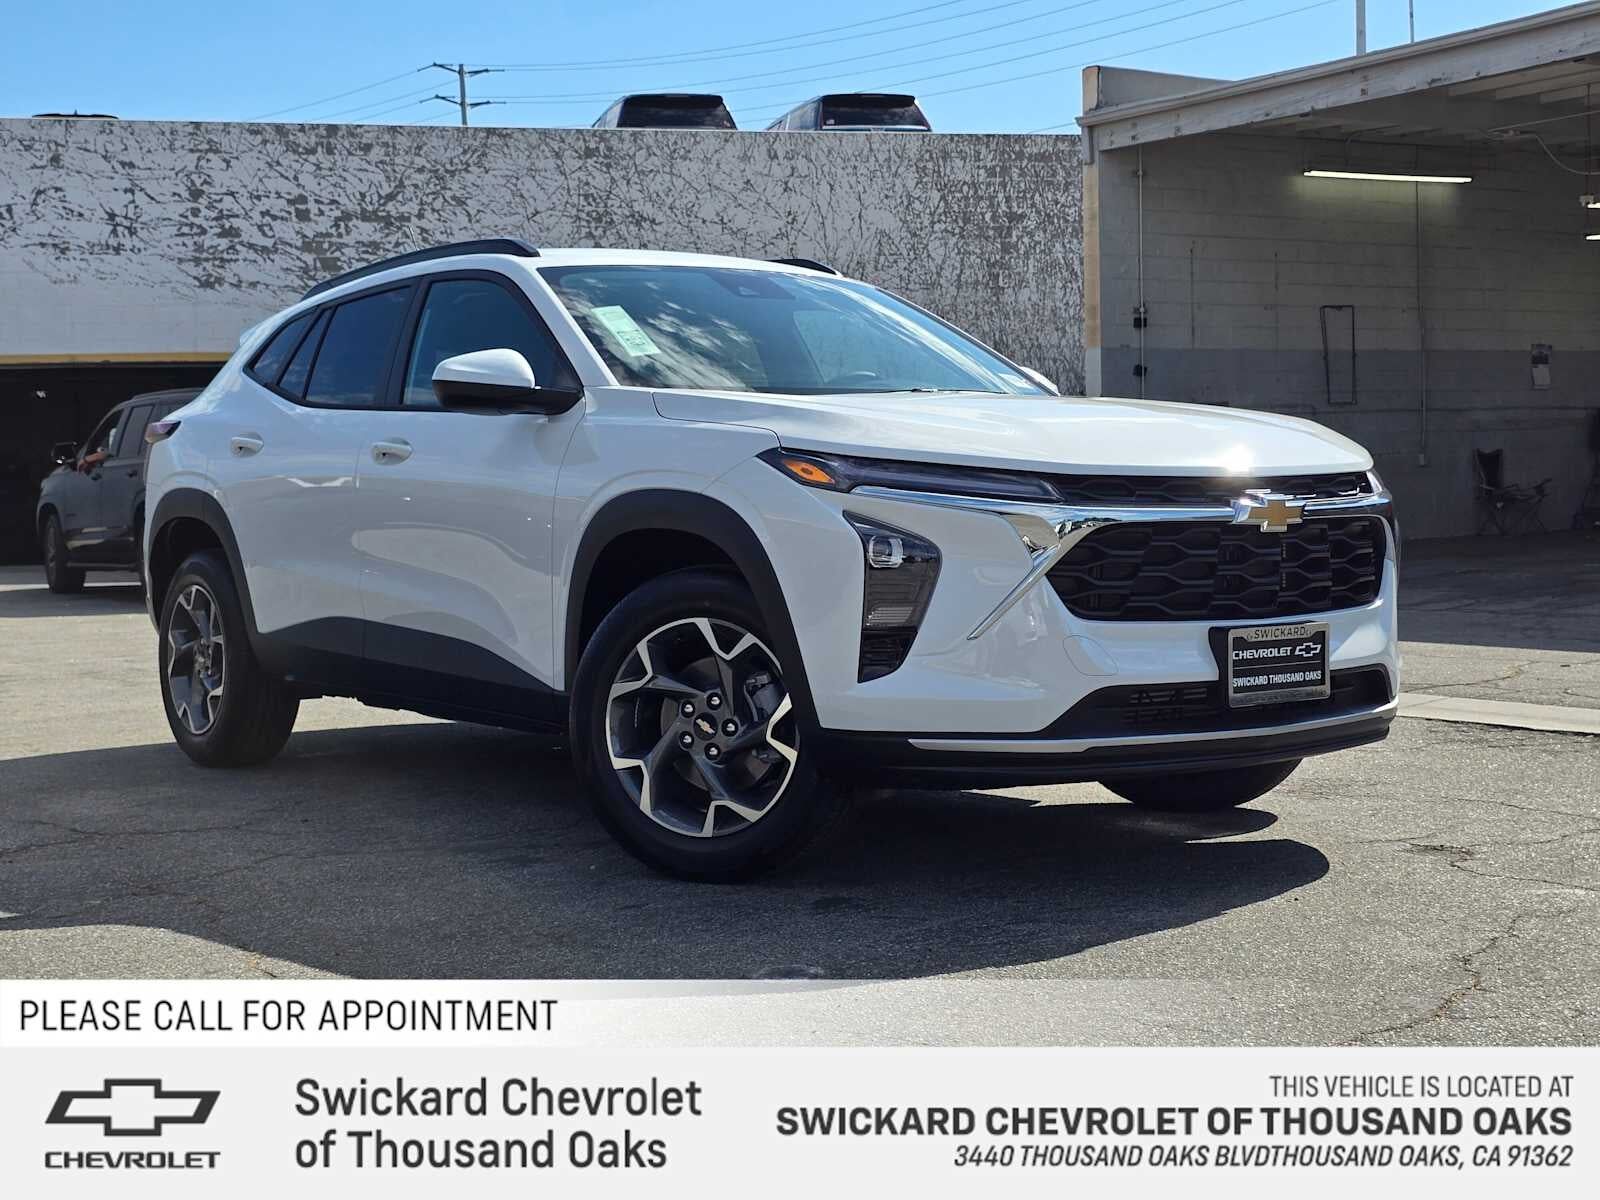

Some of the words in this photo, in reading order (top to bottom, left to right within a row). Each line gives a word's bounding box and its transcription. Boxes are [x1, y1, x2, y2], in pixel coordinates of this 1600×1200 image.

[1254, 626, 1305, 639] SWICKARD
[1232, 646, 1292, 660] CHEVROLET
[1233, 674, 1268, 687] SWICKARD
[1269, 672, 1304, 684] THOUSAND
[1305, 670, 1322, 680] OAKS
